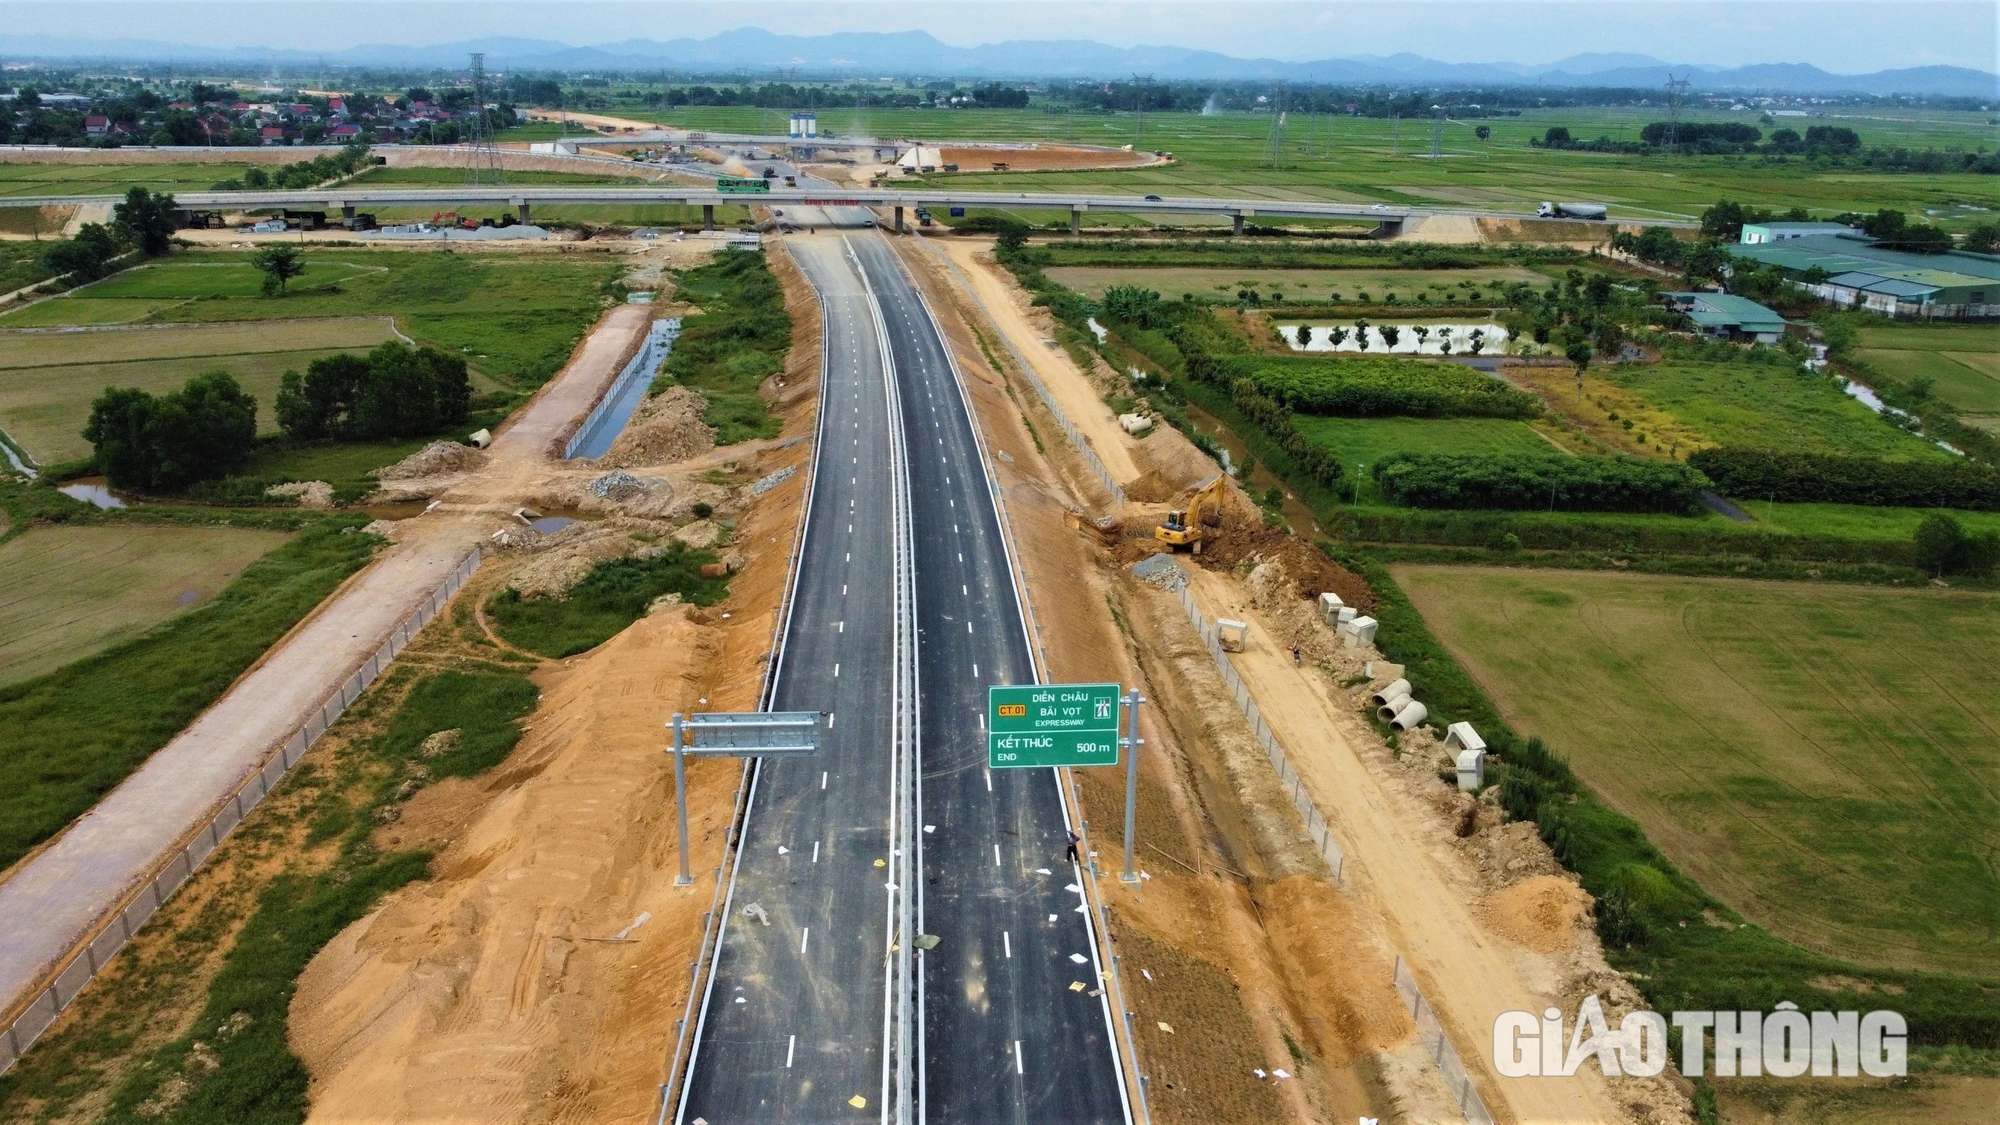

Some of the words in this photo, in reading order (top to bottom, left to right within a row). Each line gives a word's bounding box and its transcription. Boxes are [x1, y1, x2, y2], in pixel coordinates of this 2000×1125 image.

[1032, 690, 1055, 702] DIỄN
[1060, 691, 1089, 702] CHÂU
[1000, 706, 1012, 715] CT
[1015, 706, 1024, 714] 01
[1040, 706, 1057, 716] BÃI
[1062, 707, 1082, 717] VỌT
[1035, 719, 1085, 727] EXPRESSWAY
[997, 734, 1021, 749] KẾT
[1022, 734, 1053, 748] THÚC
[1076, 742, 1096, 753] 500
[1098, 744, 1110, 752] m
[997, 753, 1017, 761] END
